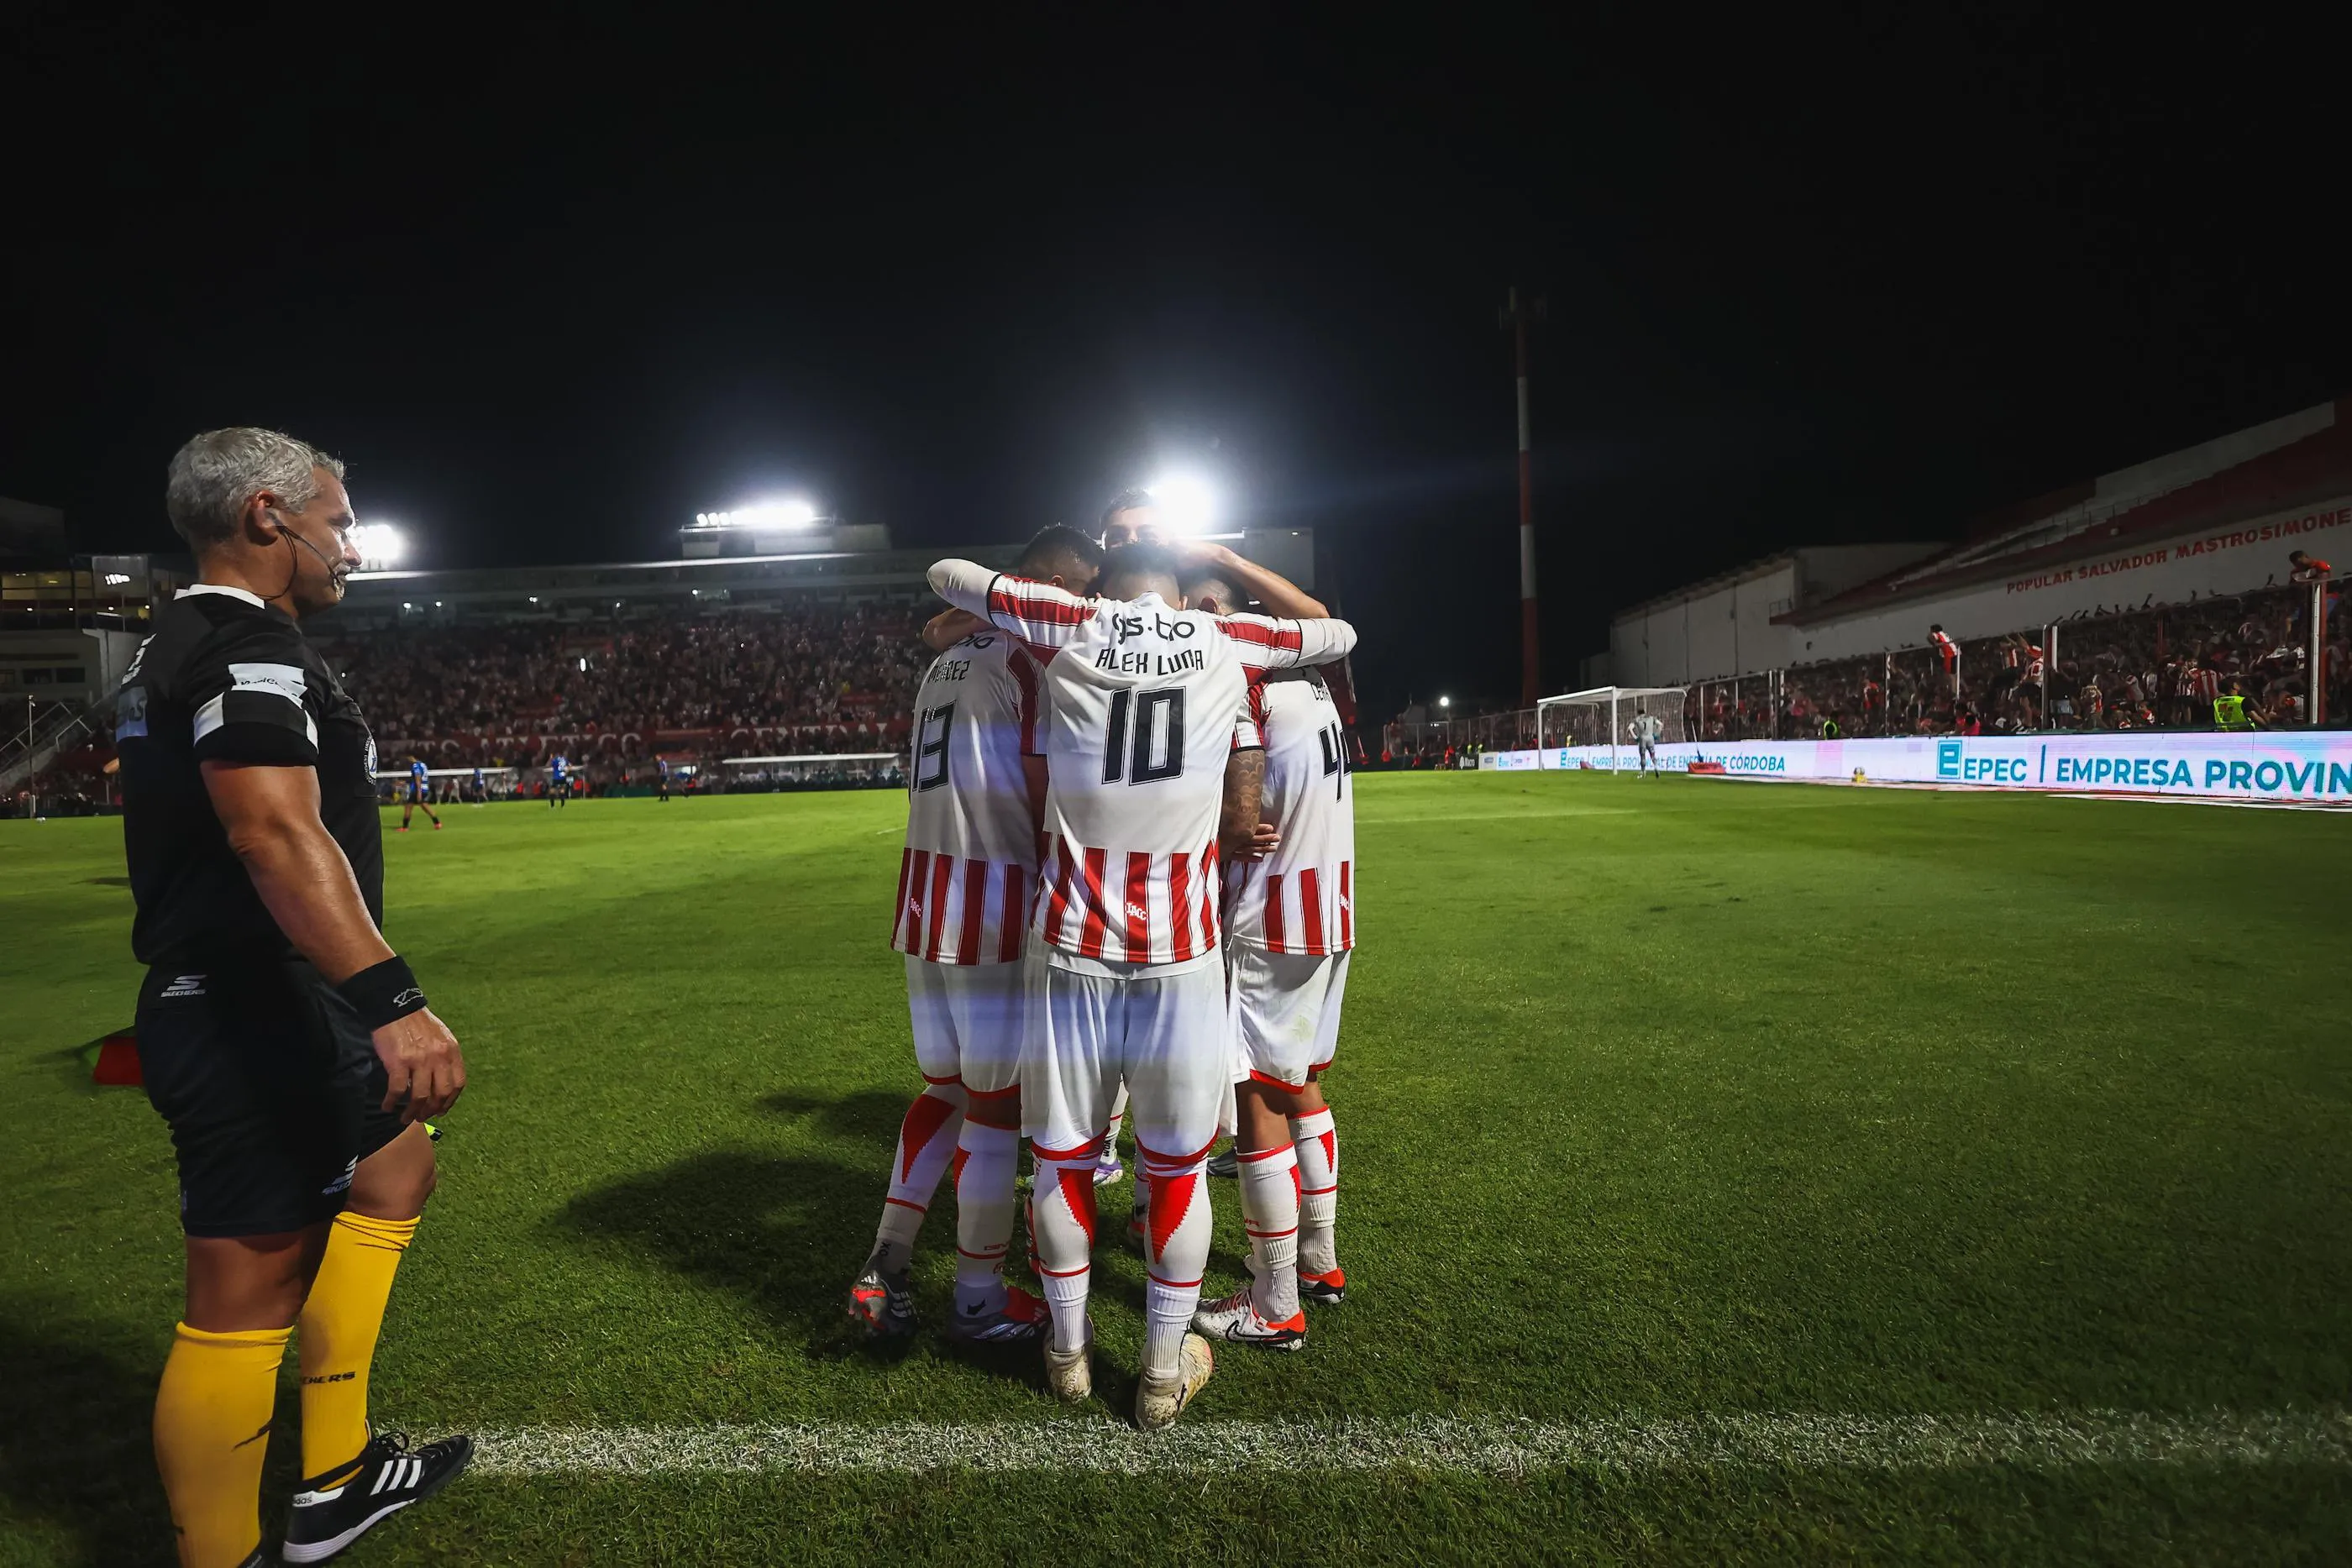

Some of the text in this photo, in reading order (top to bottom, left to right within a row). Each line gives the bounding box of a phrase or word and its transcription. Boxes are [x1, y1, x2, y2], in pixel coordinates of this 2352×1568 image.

[2007, 507, 2352, 595] POPULAR SALVADOR MASTROSIMONE
[1095, 648, 1205, 676] ALEX LUNA
[911, 699, 957, 793] 13
[1101, 685, 1187, 787] 10
[1592, 756, 1621, 768] EMPREA
[1730, 751, 1785, 772] CÓRDOBA
[1963, 757, 2352, 794] EPEC EMPRESA PROVIN
